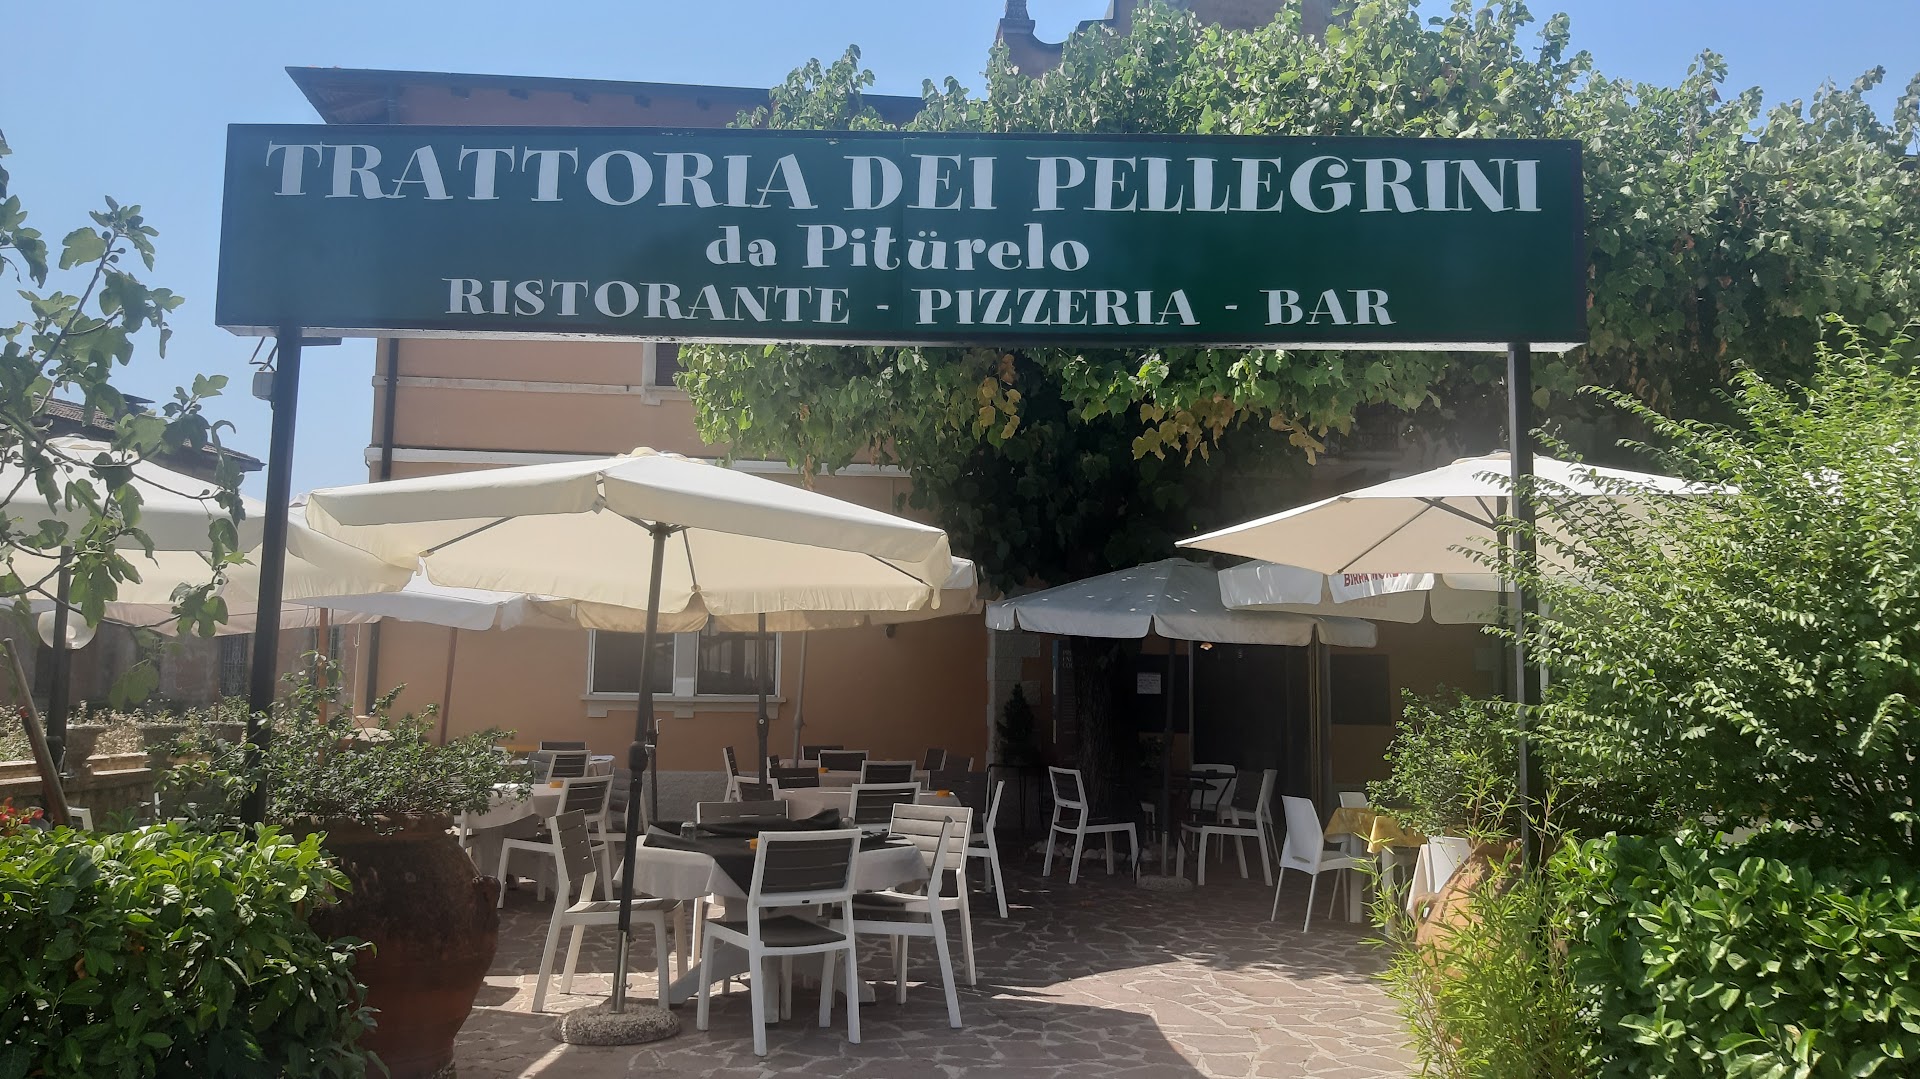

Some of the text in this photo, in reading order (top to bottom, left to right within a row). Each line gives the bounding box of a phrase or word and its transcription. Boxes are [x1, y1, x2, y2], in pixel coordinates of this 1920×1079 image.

[265, 140, 1541, 214] TRATTORIA DEI PELLEGRINI
[705, 223, 1090, 272] da Pitürelo
[441, 277, 850, 325] RISTORANTE
[876, 303, 889, 311] -
[914, 288, 1200, 326] PIZZERIA
[1260, 288, 1397, 326] BAR
